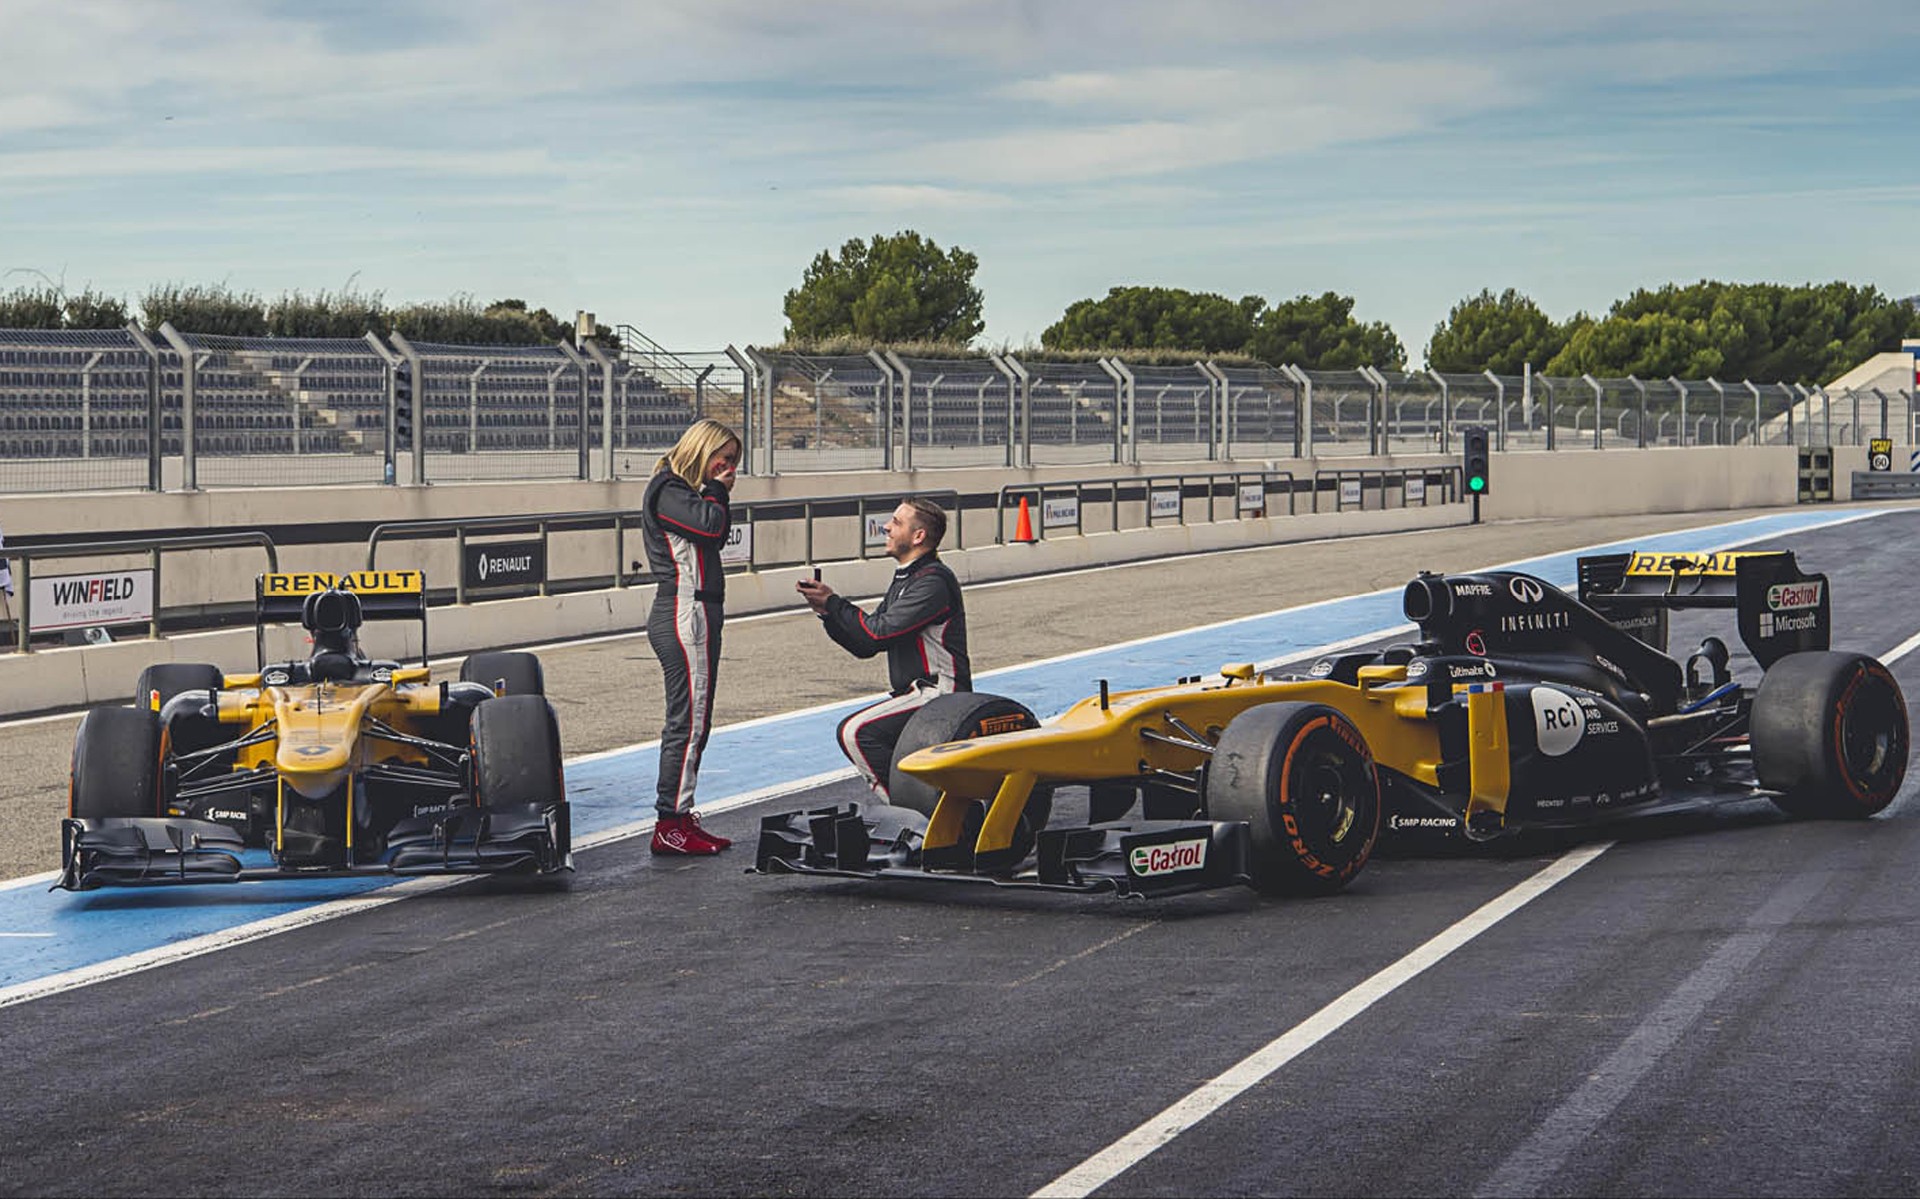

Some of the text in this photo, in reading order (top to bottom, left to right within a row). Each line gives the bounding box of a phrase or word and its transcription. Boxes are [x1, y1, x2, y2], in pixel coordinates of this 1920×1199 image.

[489, 556, 531, 573] RENAULT
[54, 577, 134, 606] WINFIELD
[270, 572, 415, 592] RENAULT
[1455, 584, 1493, 597] MAPFRE
[1781, 586, 1818, 607] Castrol
[1501, 611, 1569, 632] INFINITI
[1776, 611, 1817, 632] Microsoft
[1587, 721, 1619, 735] SERVICES
[1398, 818, 1457, 827] SMP RACING
[1150, 843, 1201, 872] Castrol
